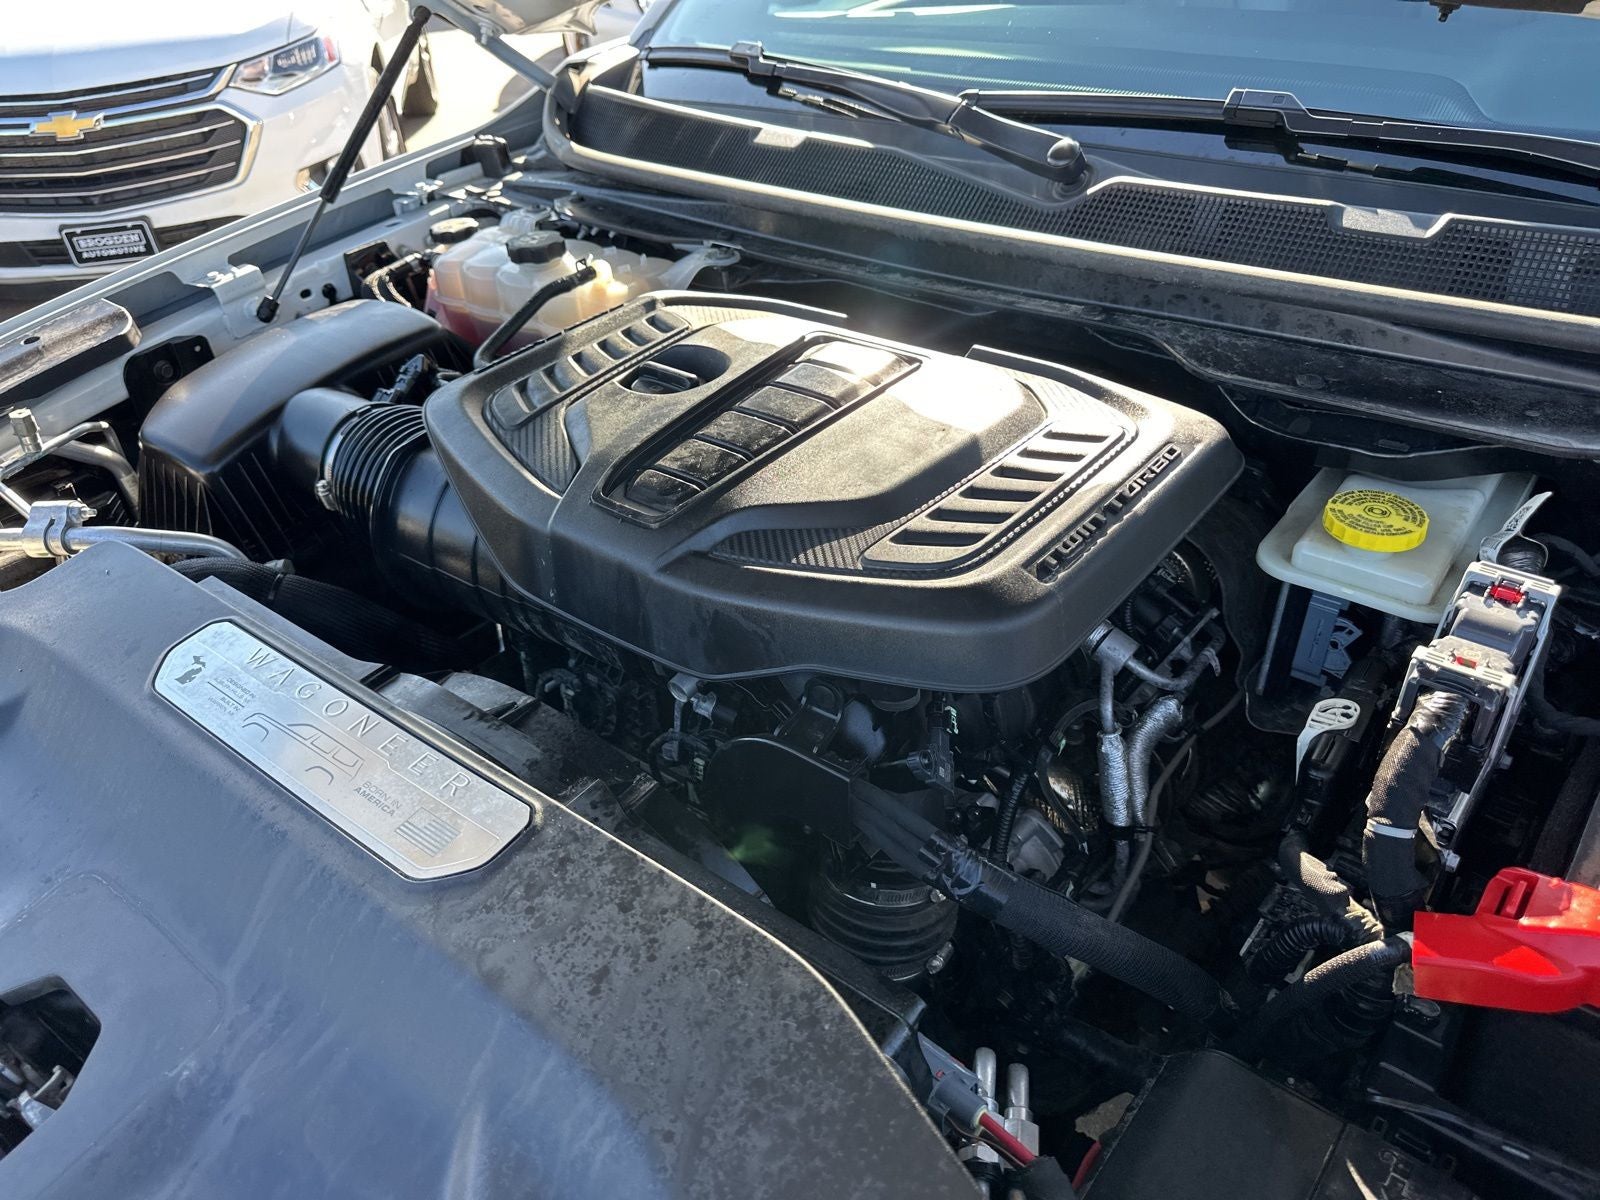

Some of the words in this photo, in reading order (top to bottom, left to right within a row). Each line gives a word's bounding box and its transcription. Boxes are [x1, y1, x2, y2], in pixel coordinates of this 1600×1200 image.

[81, 245, 147, 259] AUTOMOTIVE
[1036, 512, 1107, 571] TWIN
[1103, 443, 1182, 512] TURBO
[247, 647, 471, 797] WAGONEER
[353, 786, 396, 817] AMERICA
[361, 780, 391, 802] BORN
[391, 799, 402, 810] IN
